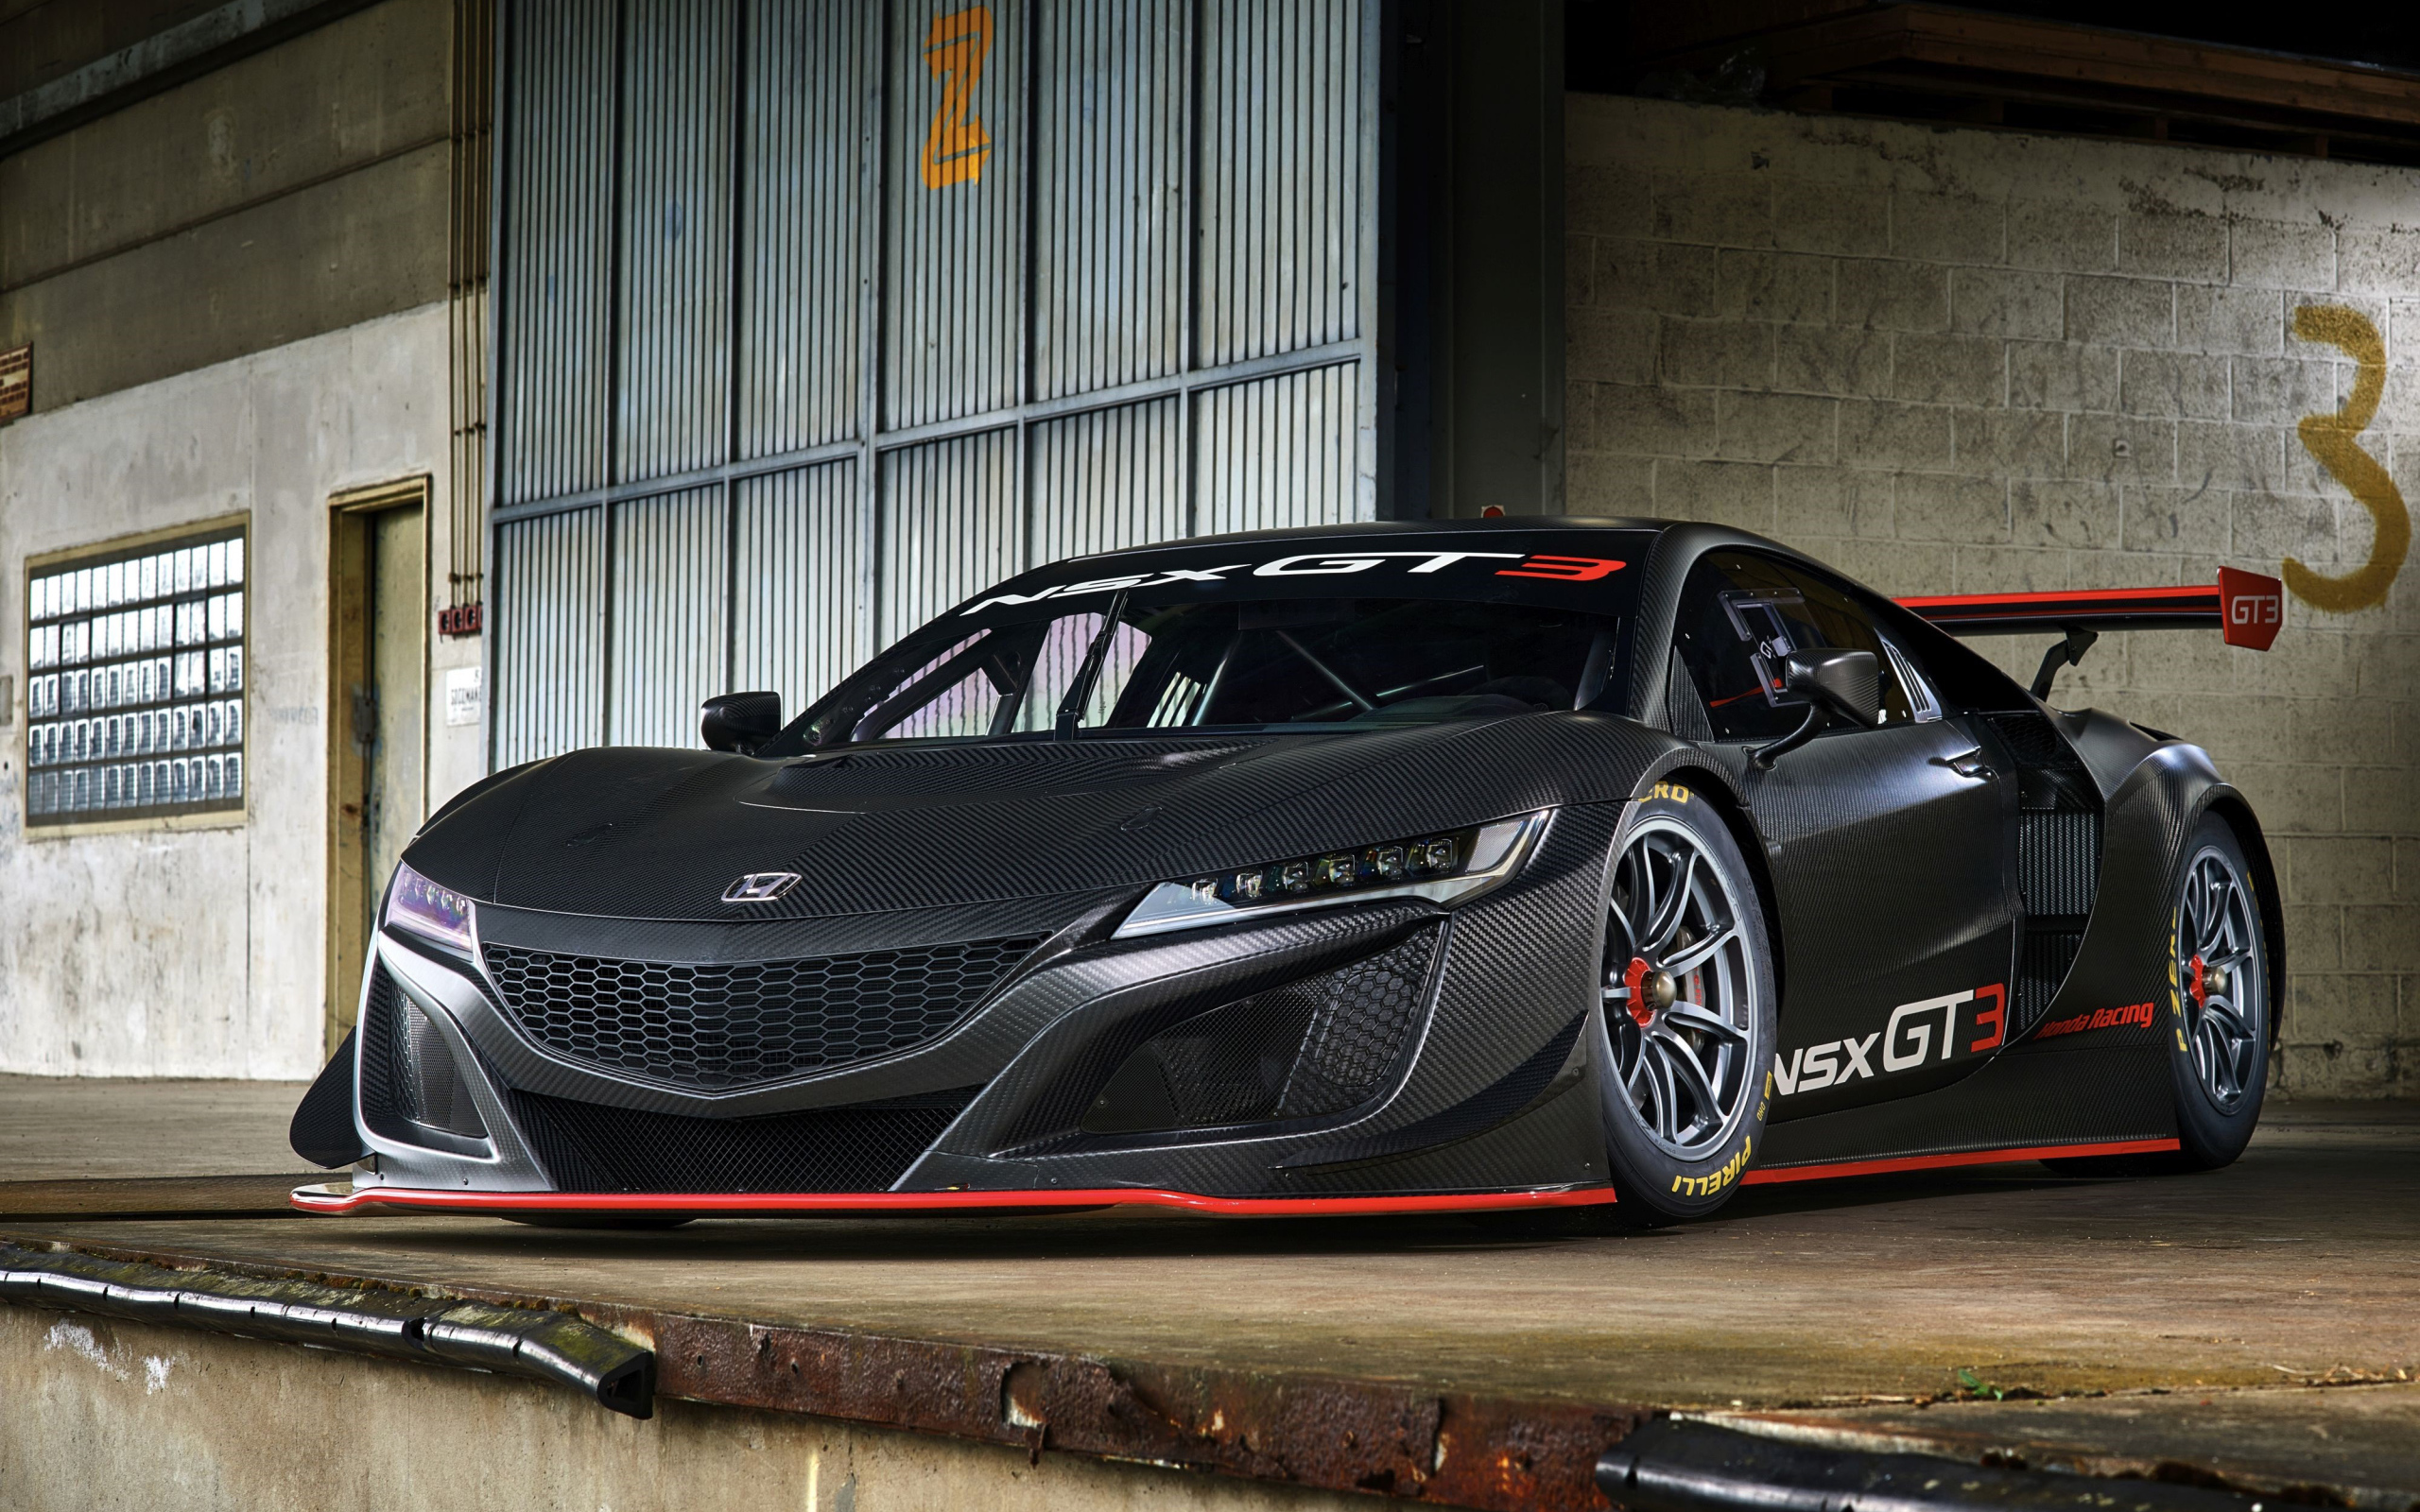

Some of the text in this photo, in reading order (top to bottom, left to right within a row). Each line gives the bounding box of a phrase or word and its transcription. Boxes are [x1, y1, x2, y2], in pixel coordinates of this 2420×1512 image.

[2281, 304, 2411, 612] 3
[2232, 595, 2279, 625] GT3
[1773, 983, 2005, 1096] NSX GT3
[2032, 1002, 2154, 1040] Honda Racing
[1671, 1136, 1753, 1197] PIRELLI
